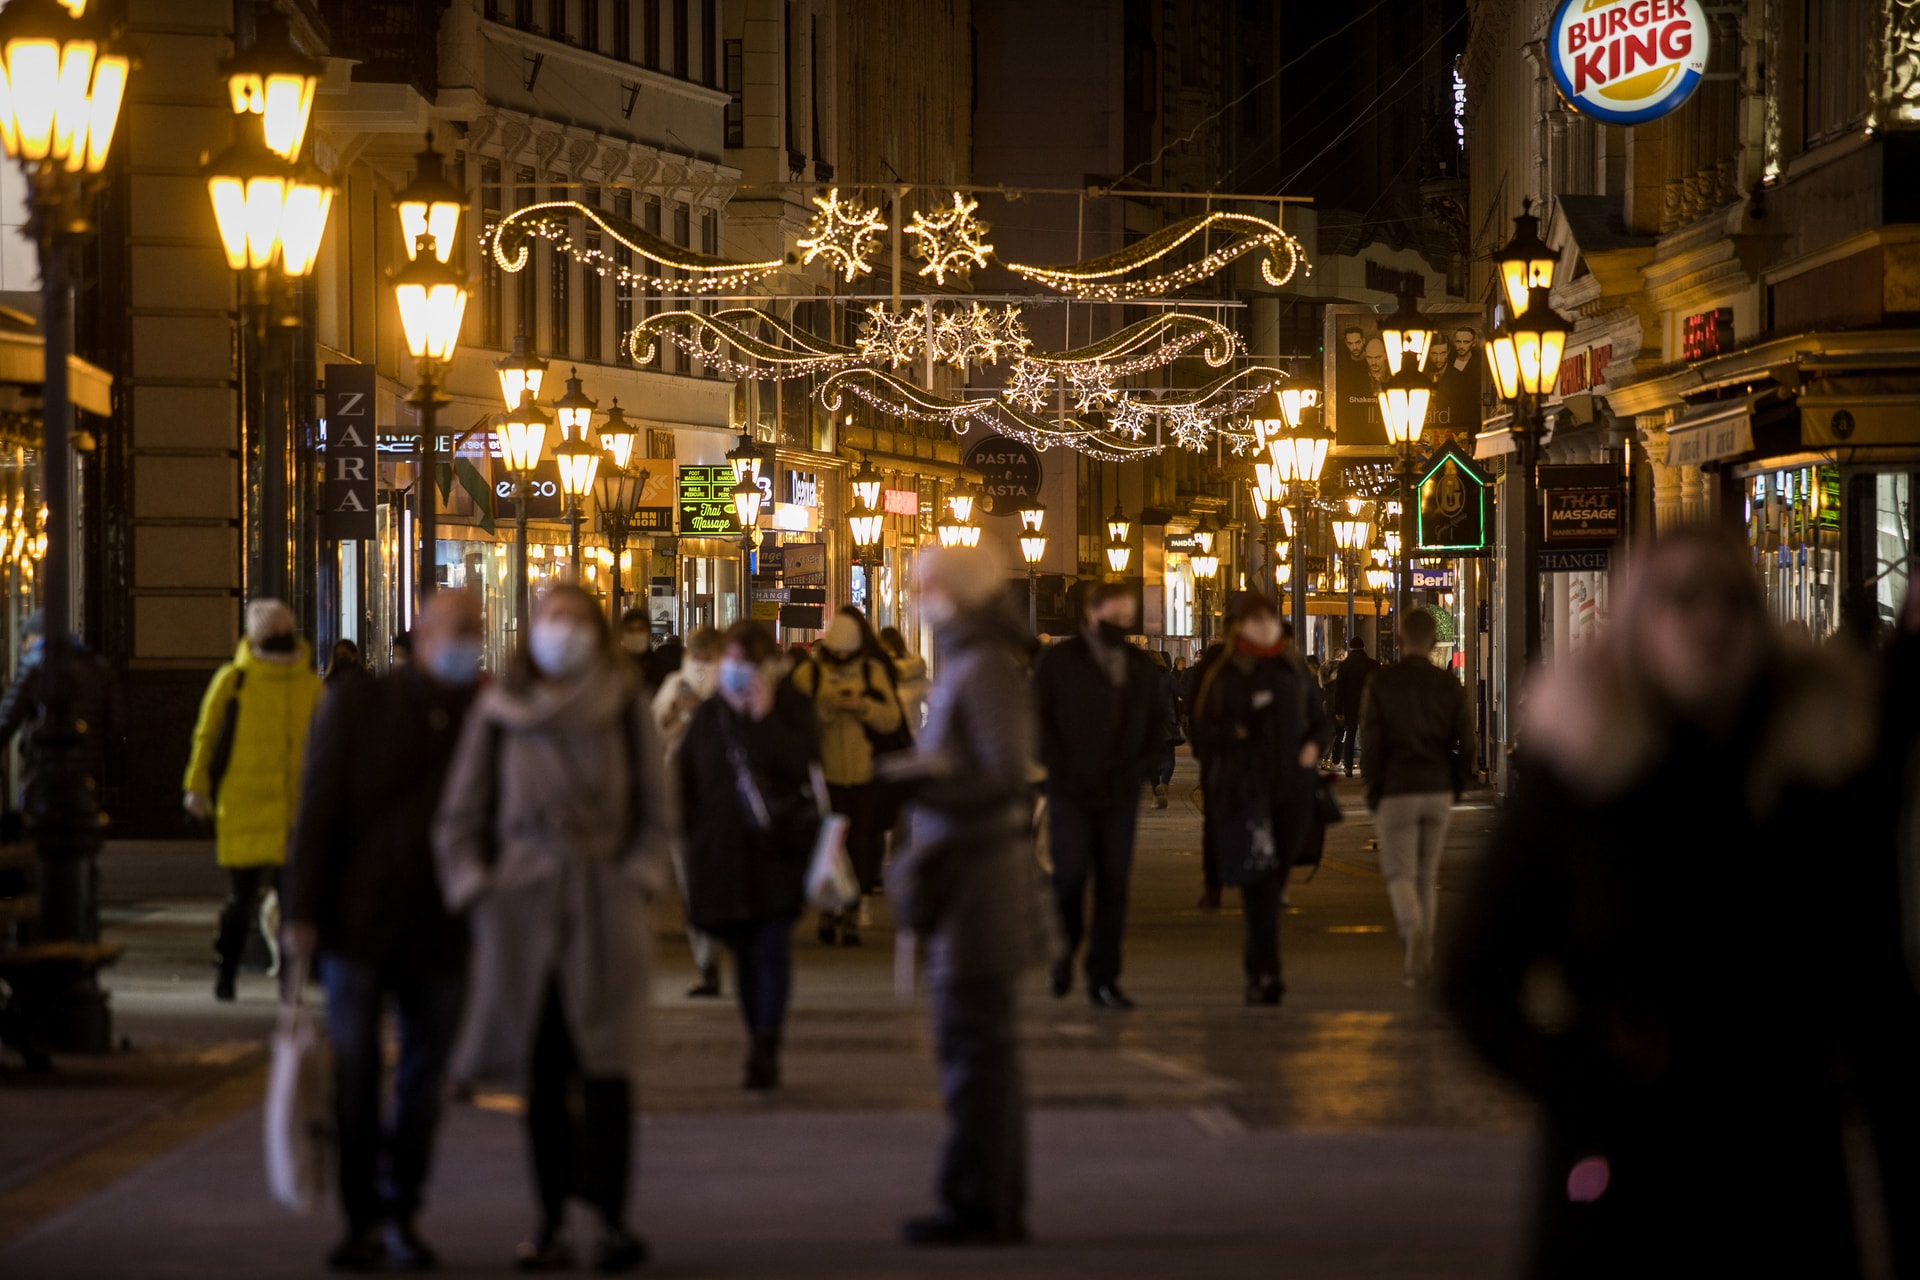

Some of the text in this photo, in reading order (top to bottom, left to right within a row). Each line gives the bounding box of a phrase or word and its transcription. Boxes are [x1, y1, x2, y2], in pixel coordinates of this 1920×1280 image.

[1568, 0, 1687, 55] BURGER
[1574, 20, 1692, 95] KING
[333, 392, 369, 512] ZARA
[975, 453, 1028, 465] PASTA
[1559, 494, 1609, 509] THAI
[700, 502, 722, 517] Thai
[1552, 509, 1617, 521] MASSAGE
[629, 519, 657, 527] NION
[692, 516, 731, 532] Massage
